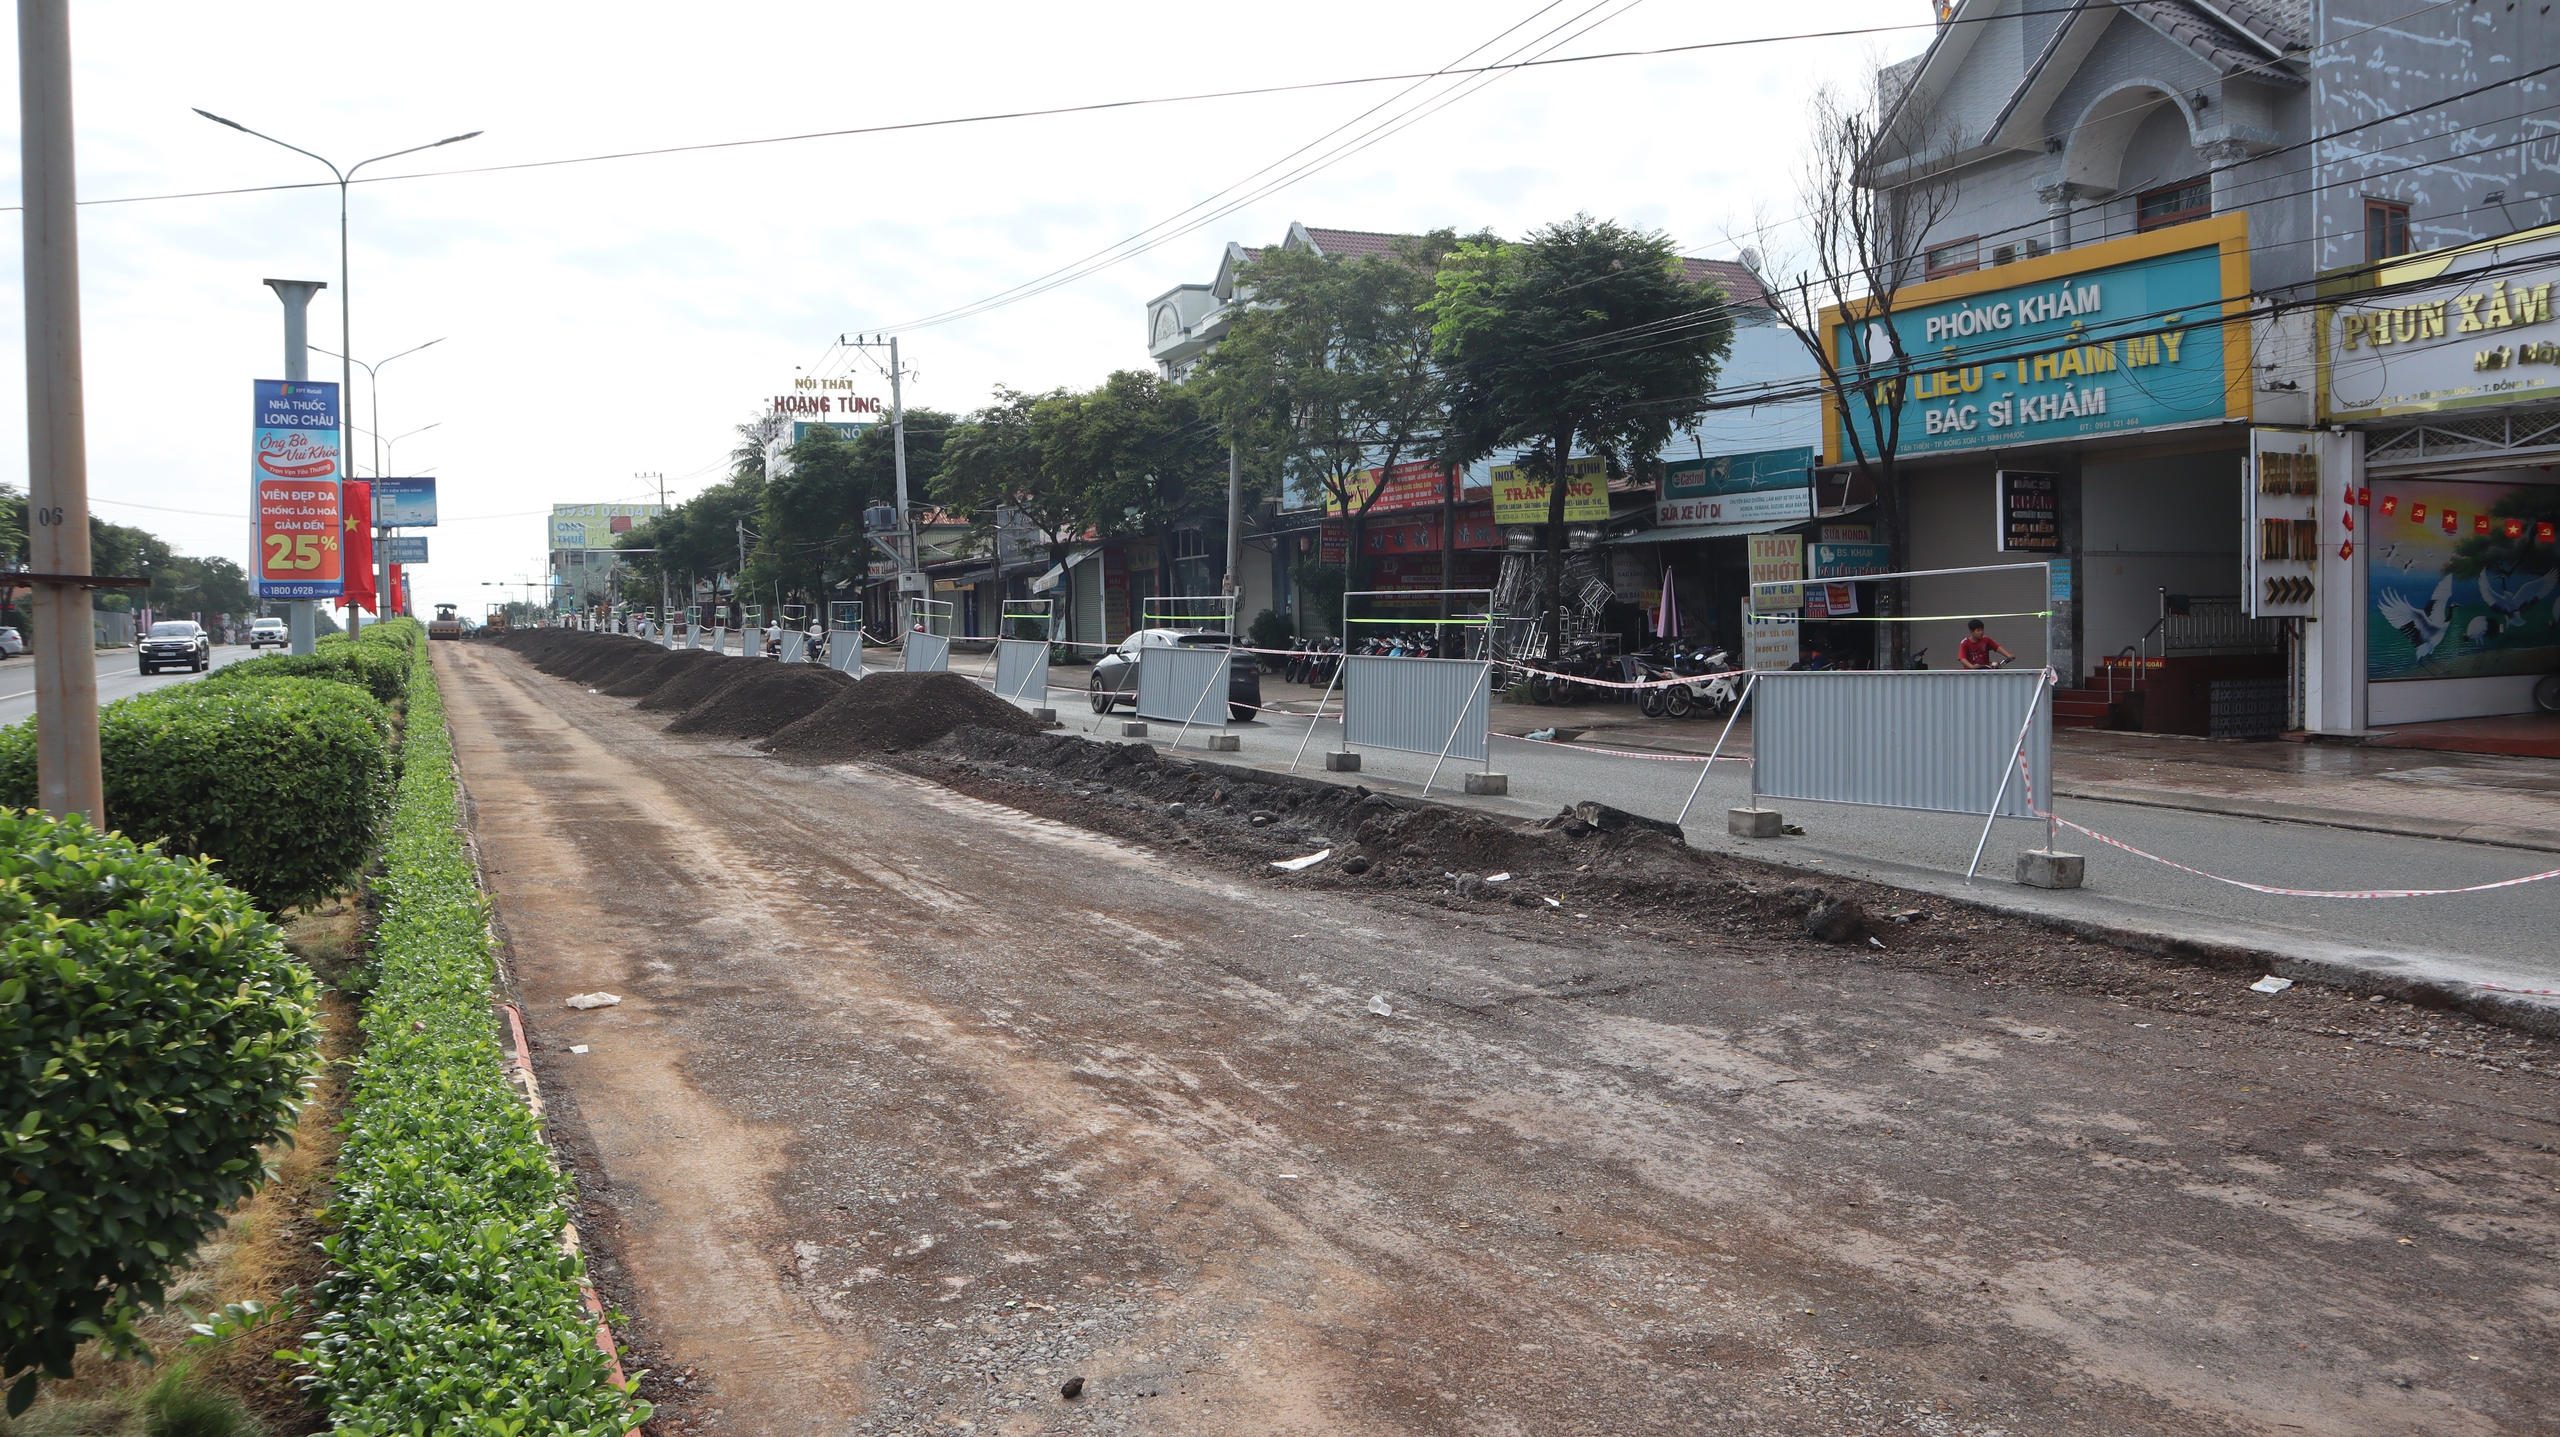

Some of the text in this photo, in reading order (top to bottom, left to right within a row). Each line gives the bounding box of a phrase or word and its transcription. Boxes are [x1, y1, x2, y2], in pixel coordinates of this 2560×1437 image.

[1926, 280, 2101, 342] PHÒNG KHÁM
[2342, 280, 2554, 350] PHUN XĂM
[2127, 314, 2188, 368] MỸ
[795, 376, 853, 390] NỘI THẤT
[2442, 385, 2475, 397] PHƯỚC
[2527, 378, 2545, 387] NAI
[269, 398, 326, 411] NHÀ THUỐC
[774, 391, 830, 413] HOÀNG
[838, 392, 881, 413] TÙNG
[1926, 382, 2106, 434] BÁC SĨ KHẢM
[264, 412, 334, 426] LONG CHÂU
[2095, 421, 2110, 429] 0913
[2114, 420, 2123, 428] 121
[2126, 418, 2139, 426] 464
[260, 432, 308, 452] Ông Bà
[1912, 442, 1930, 450] THIỆN
[1944, 437, 1961, 447] ĐỒNG
[1962, 435, 1976, 445] XOÀI
[2003, 431, 2024, 440] PHƯỚC
[286, 446, 339, 461] Vui Khỏe
[1495, 470, 1515, 481] INOX
[1577, 461, 1600, 476] KÍNH
[1680, 470, 1704, 485] Castrol
[2014, 477, 2038, 488] BÁC
[261, 489, 335, 503] VIÊN ĐẸP DA
[1504, 481, 1545, 501] TRẦN
[262, 505, 337, 516] CHỐNG LÃO HOÁ
[556, 506, 596, 517] 0934
[602, 506, 620, 517] 03
[626, 506, 645, 517] 04
[1661, 500, 1722, 521] SỬA XE ÚT DI
[274, 519, 325, 530] GIẢM ĐẾN
[1842, 529, 1868, 540] HONDA
[265, 534, 338, 571] 25%
[1754, 539, 1797, 557] THAY
[1837, 548, 1849, 557] BS.
[1753, 560, 1799, 581] NHỚT
[270, 586, 291, 595] 1800
[292, 586, 314, 595] 6928
[1761, 584, 1794, 595] TAY GA
[1777, 613, 1795, 624] DI
[1807, 609, 1827, 618] 100K
[1757, 660, 1763, 668] XE
[1773, 659, 1789, 667] HONDA
